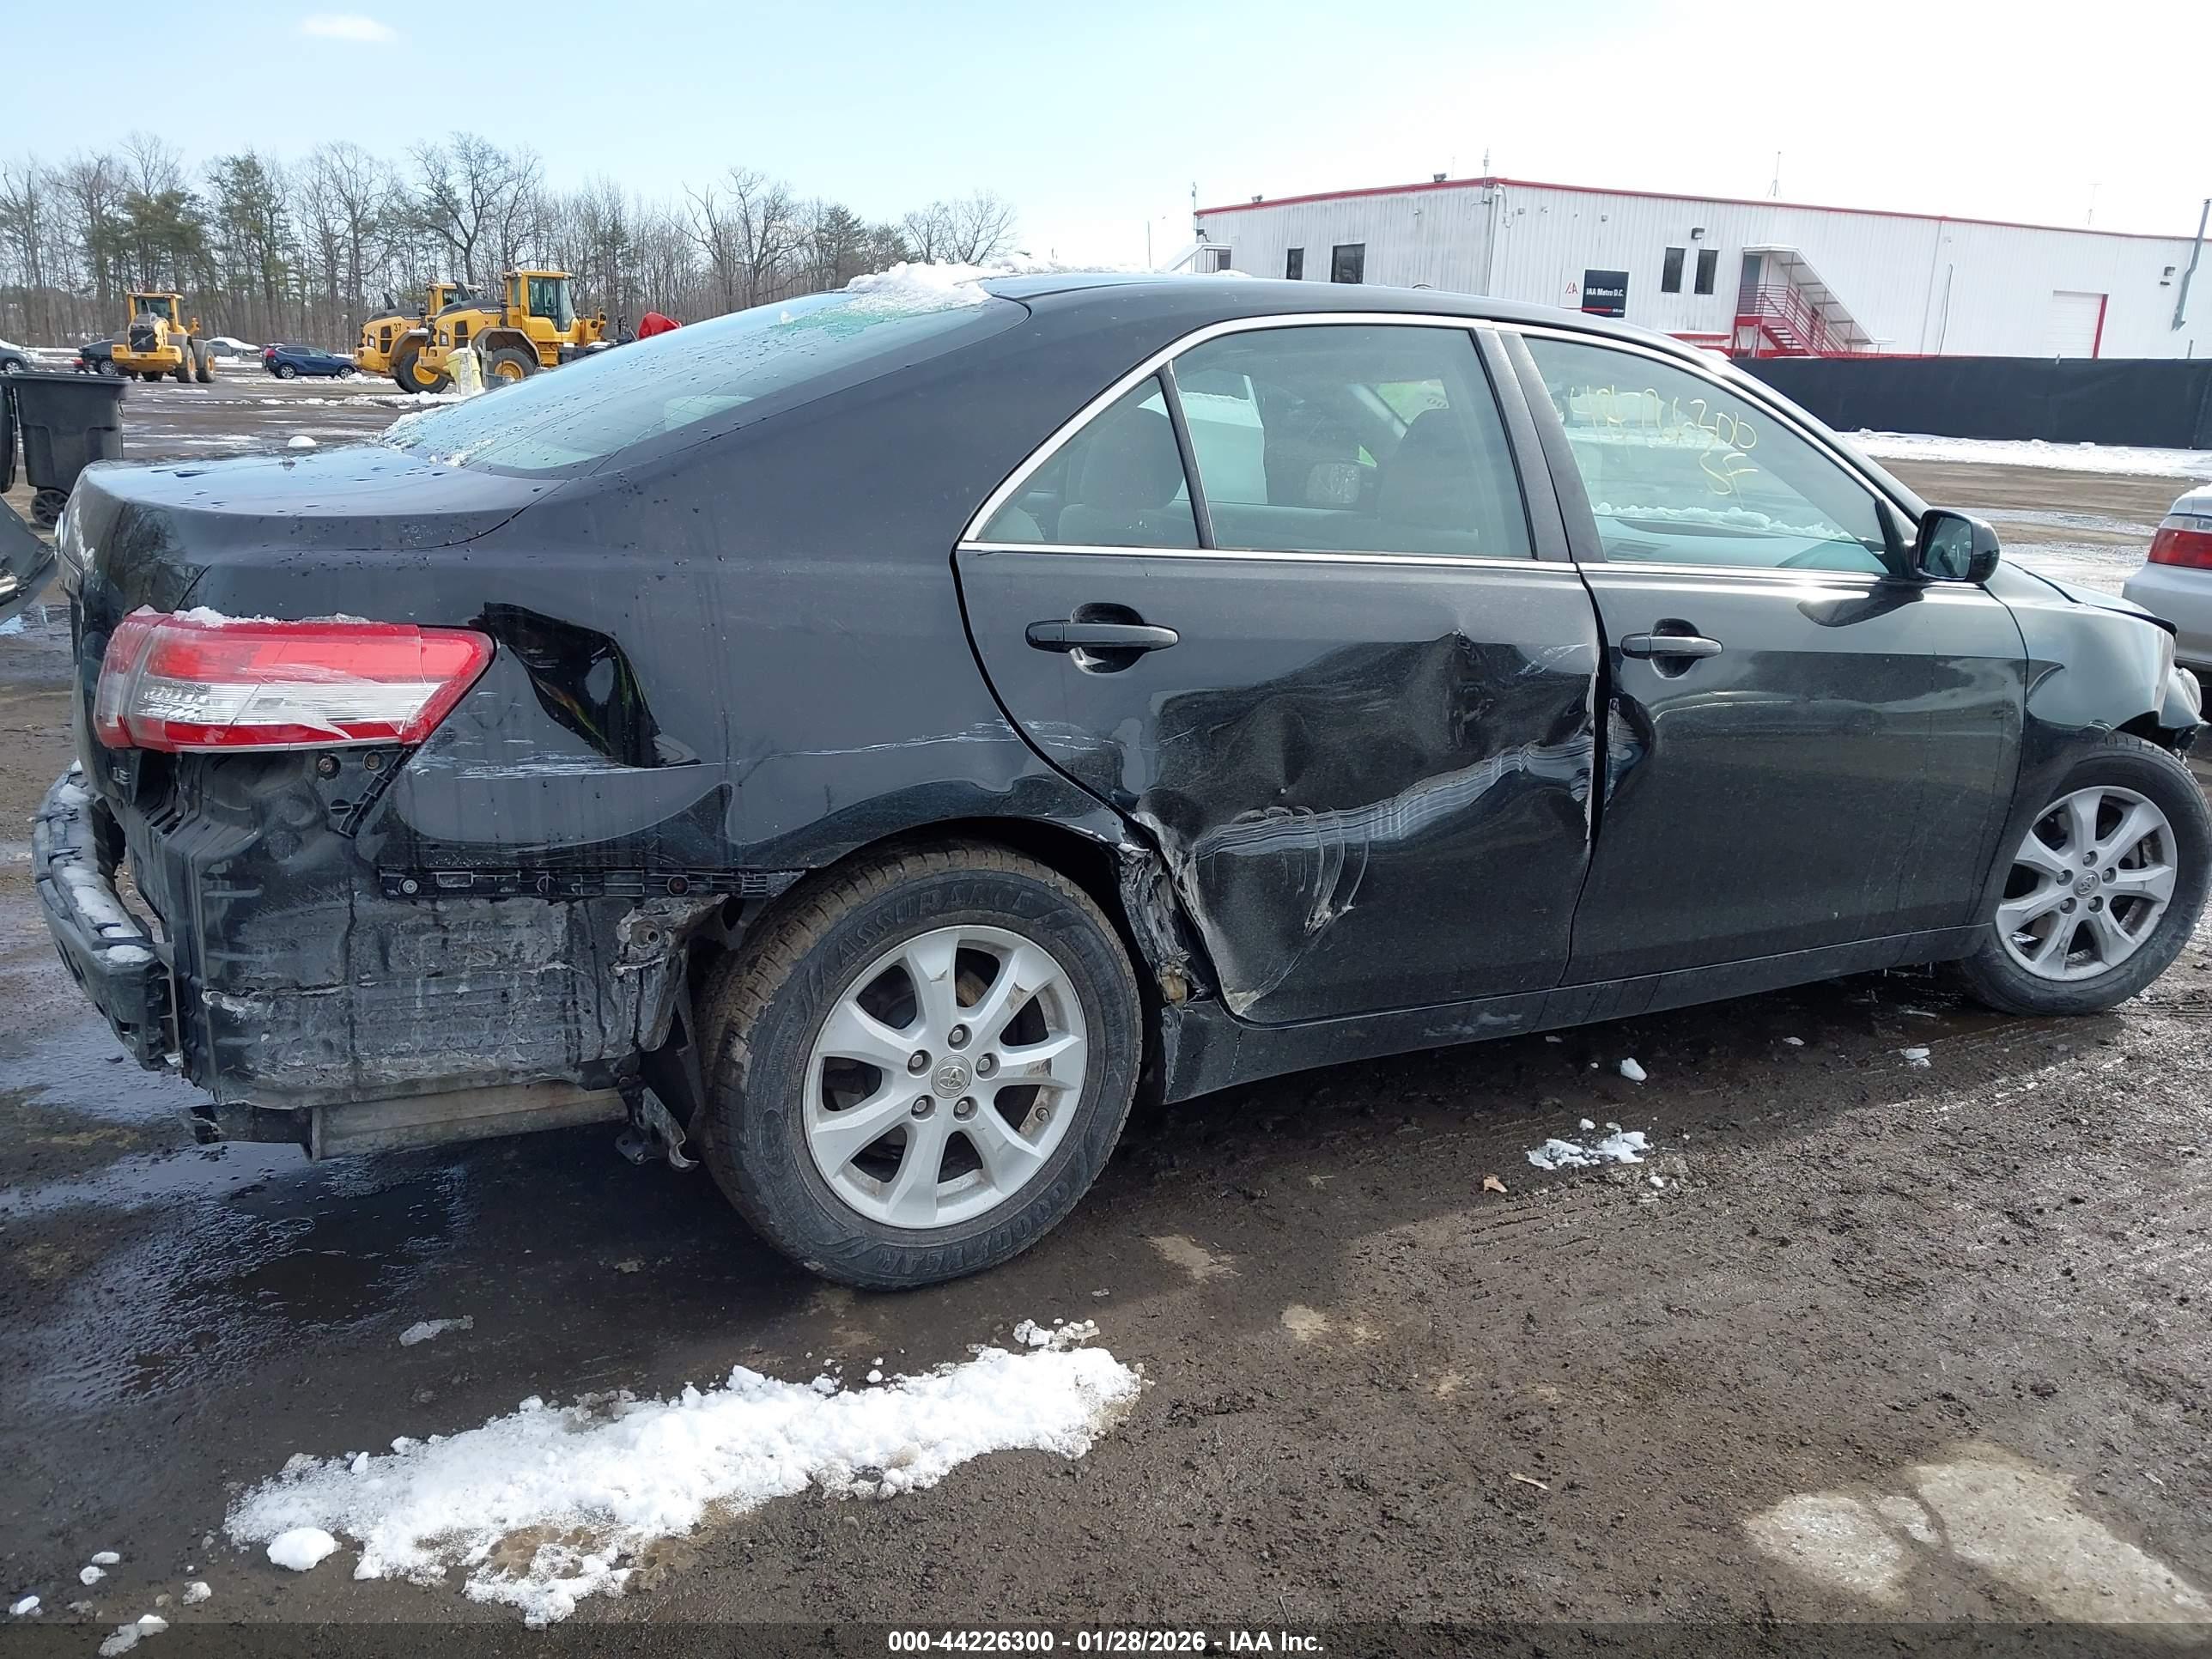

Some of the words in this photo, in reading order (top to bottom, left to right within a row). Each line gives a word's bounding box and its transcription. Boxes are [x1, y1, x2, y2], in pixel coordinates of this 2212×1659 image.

[1586, 288, 1597, 296] IAA
[1597, 288, 1613, 296] Metro
[393, 323, 402, 332] 37
[836, 884, 1036, 969] ASSURANCE
